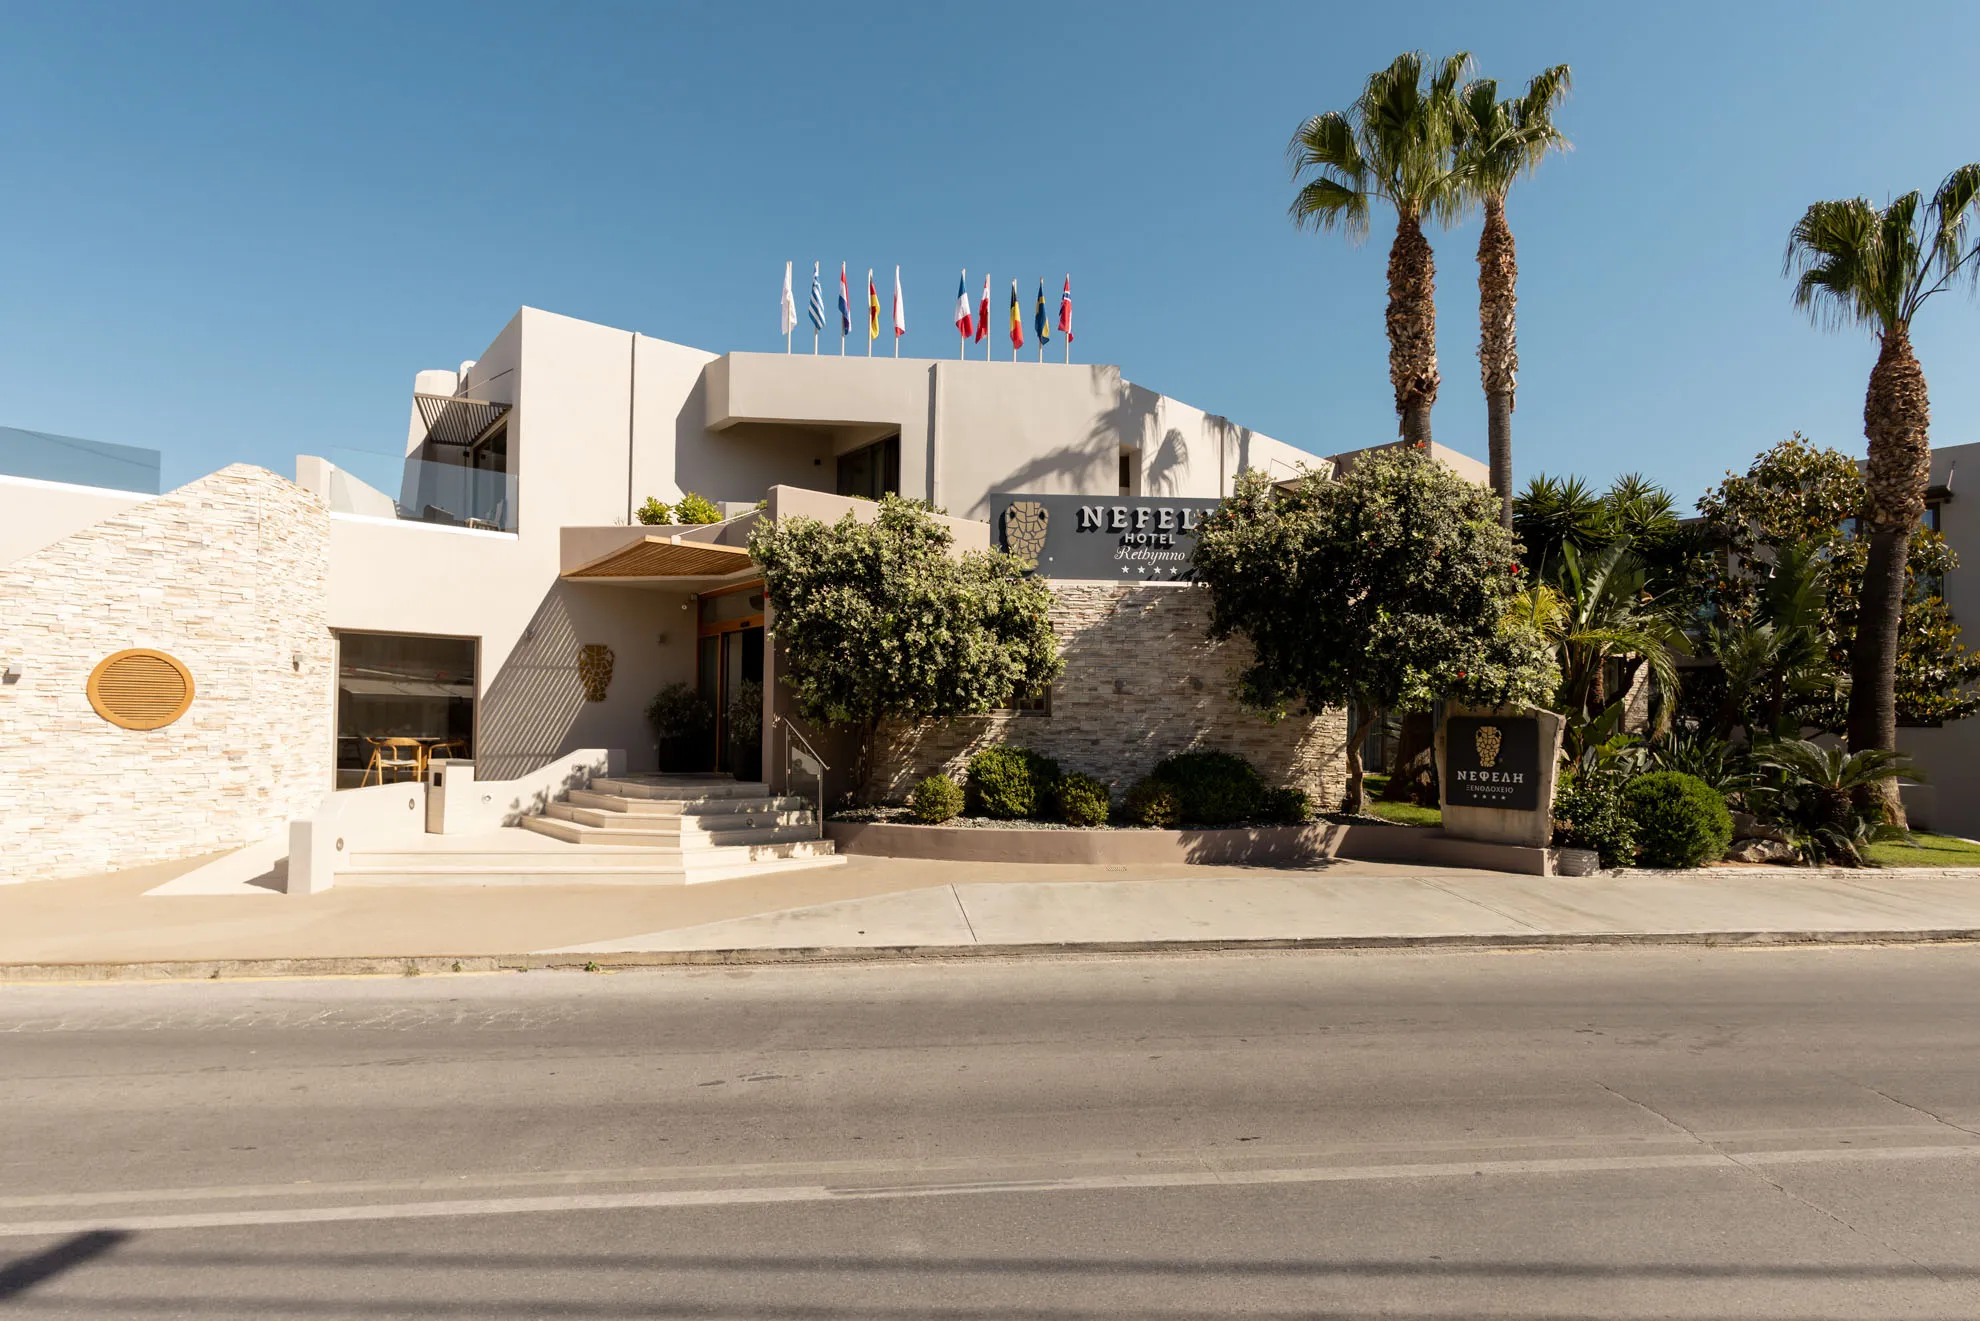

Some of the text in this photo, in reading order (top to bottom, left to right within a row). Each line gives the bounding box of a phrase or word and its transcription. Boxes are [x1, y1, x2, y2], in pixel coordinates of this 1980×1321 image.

[1124, 533, 1176, 545] HOTEL
[1113, 546, 1186, 566] Rethymno
[1457, 770, 1524, 784] ΝΕΦΕΛΗ
[1466, 784, 1514, 794] ΞΕΝΟΔΟΧΕΙΟ
